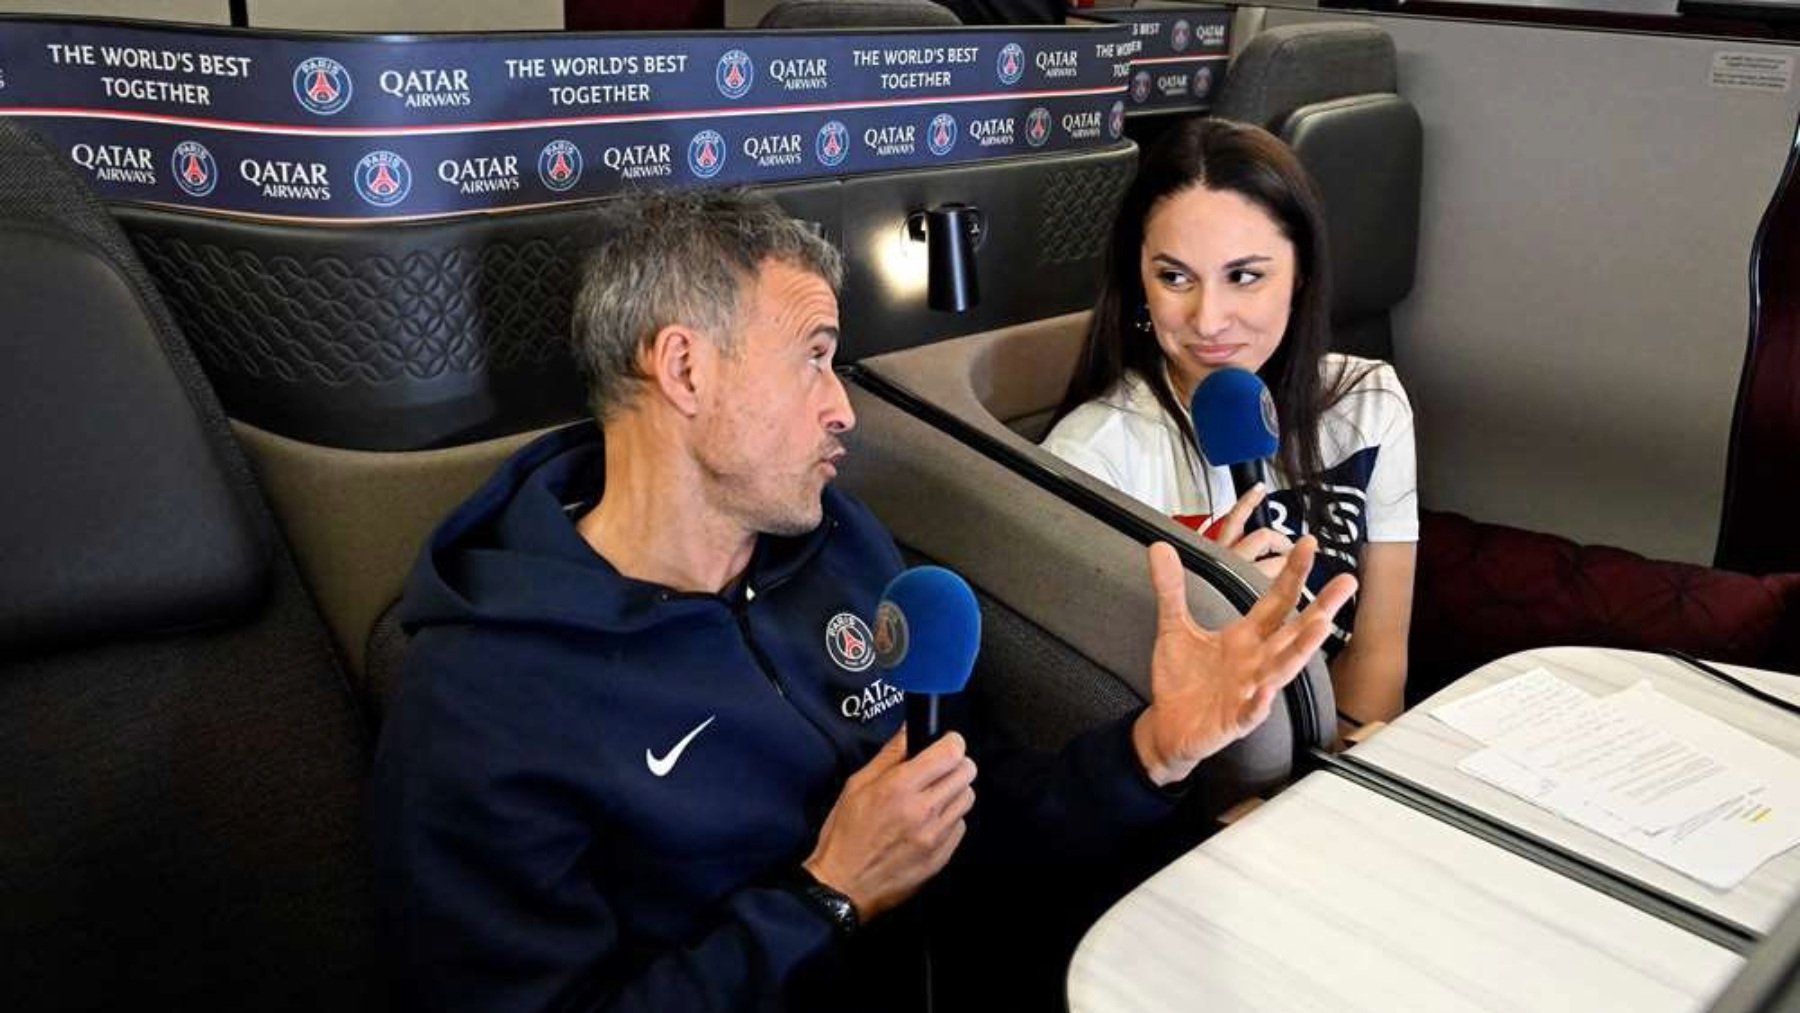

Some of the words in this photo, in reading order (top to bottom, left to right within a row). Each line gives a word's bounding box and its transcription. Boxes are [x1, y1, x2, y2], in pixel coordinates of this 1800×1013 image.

[48, 44, 97, 66] THE
[100, 46, 194, 74] WORLD'S
[199, 54, 251, 78] BEST
[853, 50, 880, 67] THE
[884, 48, 945, 66] WORLD'S
[948, 48, 979, 63] BEST
[1036, 50, 1078, 70] QATAR
[1096, 44, 1115, 58] THE
[505, 59, 545, 79] THE
[552, 56, 638, 78] WORLD'S
[644, 55, 688, 74] BEST
[770, 59, 827, 81] QATAR
[101, 76, 211, 105] TOGETHER
[379, 69, 469, 96] QATAR
[784, 77, 827, 91] AIRWAYS
[881, 72, 951, 90] TOGETHER
[405, 92, 471, 108] AIRWAYS
[549, 83, 650, 105] TOGETHER
[969, 118, 1015, 138] QATAR
[1062, 112, 1101, 132] QATAR
[744, 134, 801, 158] QATAR
[864, 125, 915, 148] QATAR
[71, 143, 152, 169] QATAR
[604, 144, 671, 170] QATAR
[758, 153, 801, 168] AIRWAYS
[876, 144, 915, 157] AIRWAYS
[96, 167, 156, 185] AIRWAYS
[240, 158, 328, 186] QATAR
[438, 156, 519, 185] QATAR
[621, 164, 672, 180] AIRWAYS
[262, 184, 331, 201] AIRWAYS
[461, 177, 520, 194] AIRWAYS
[829, 616, 855, 636] PARIS
[842, 679, 898, 717] QATA
[863, 690, 905, 722] AIRWAY
